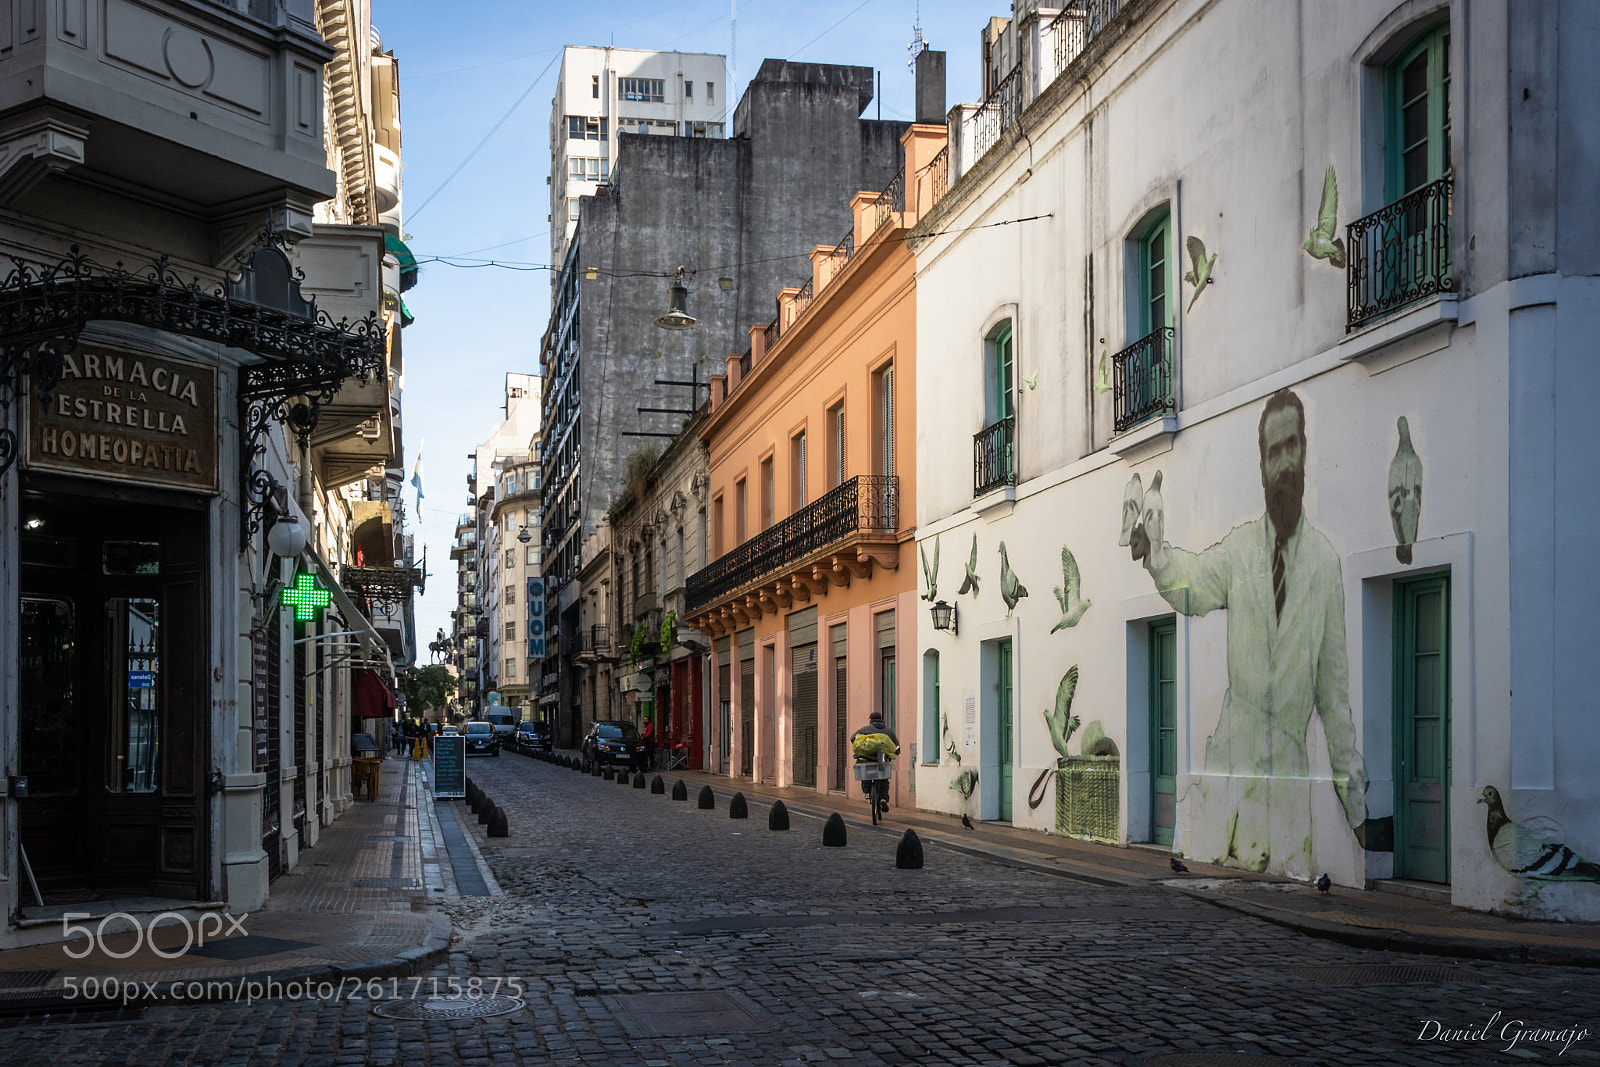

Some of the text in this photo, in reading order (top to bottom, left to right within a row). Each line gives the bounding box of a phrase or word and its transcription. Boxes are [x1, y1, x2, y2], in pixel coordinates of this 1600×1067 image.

[40, 351, 198, 407] ARMACIA
[103, 385, 147, 403] DE LA
[57, 393, 188, 436] ESTRELLA
[41, 427, 201, 474] HOMEOPATIA
[530, 600, 544, 655] UOM
